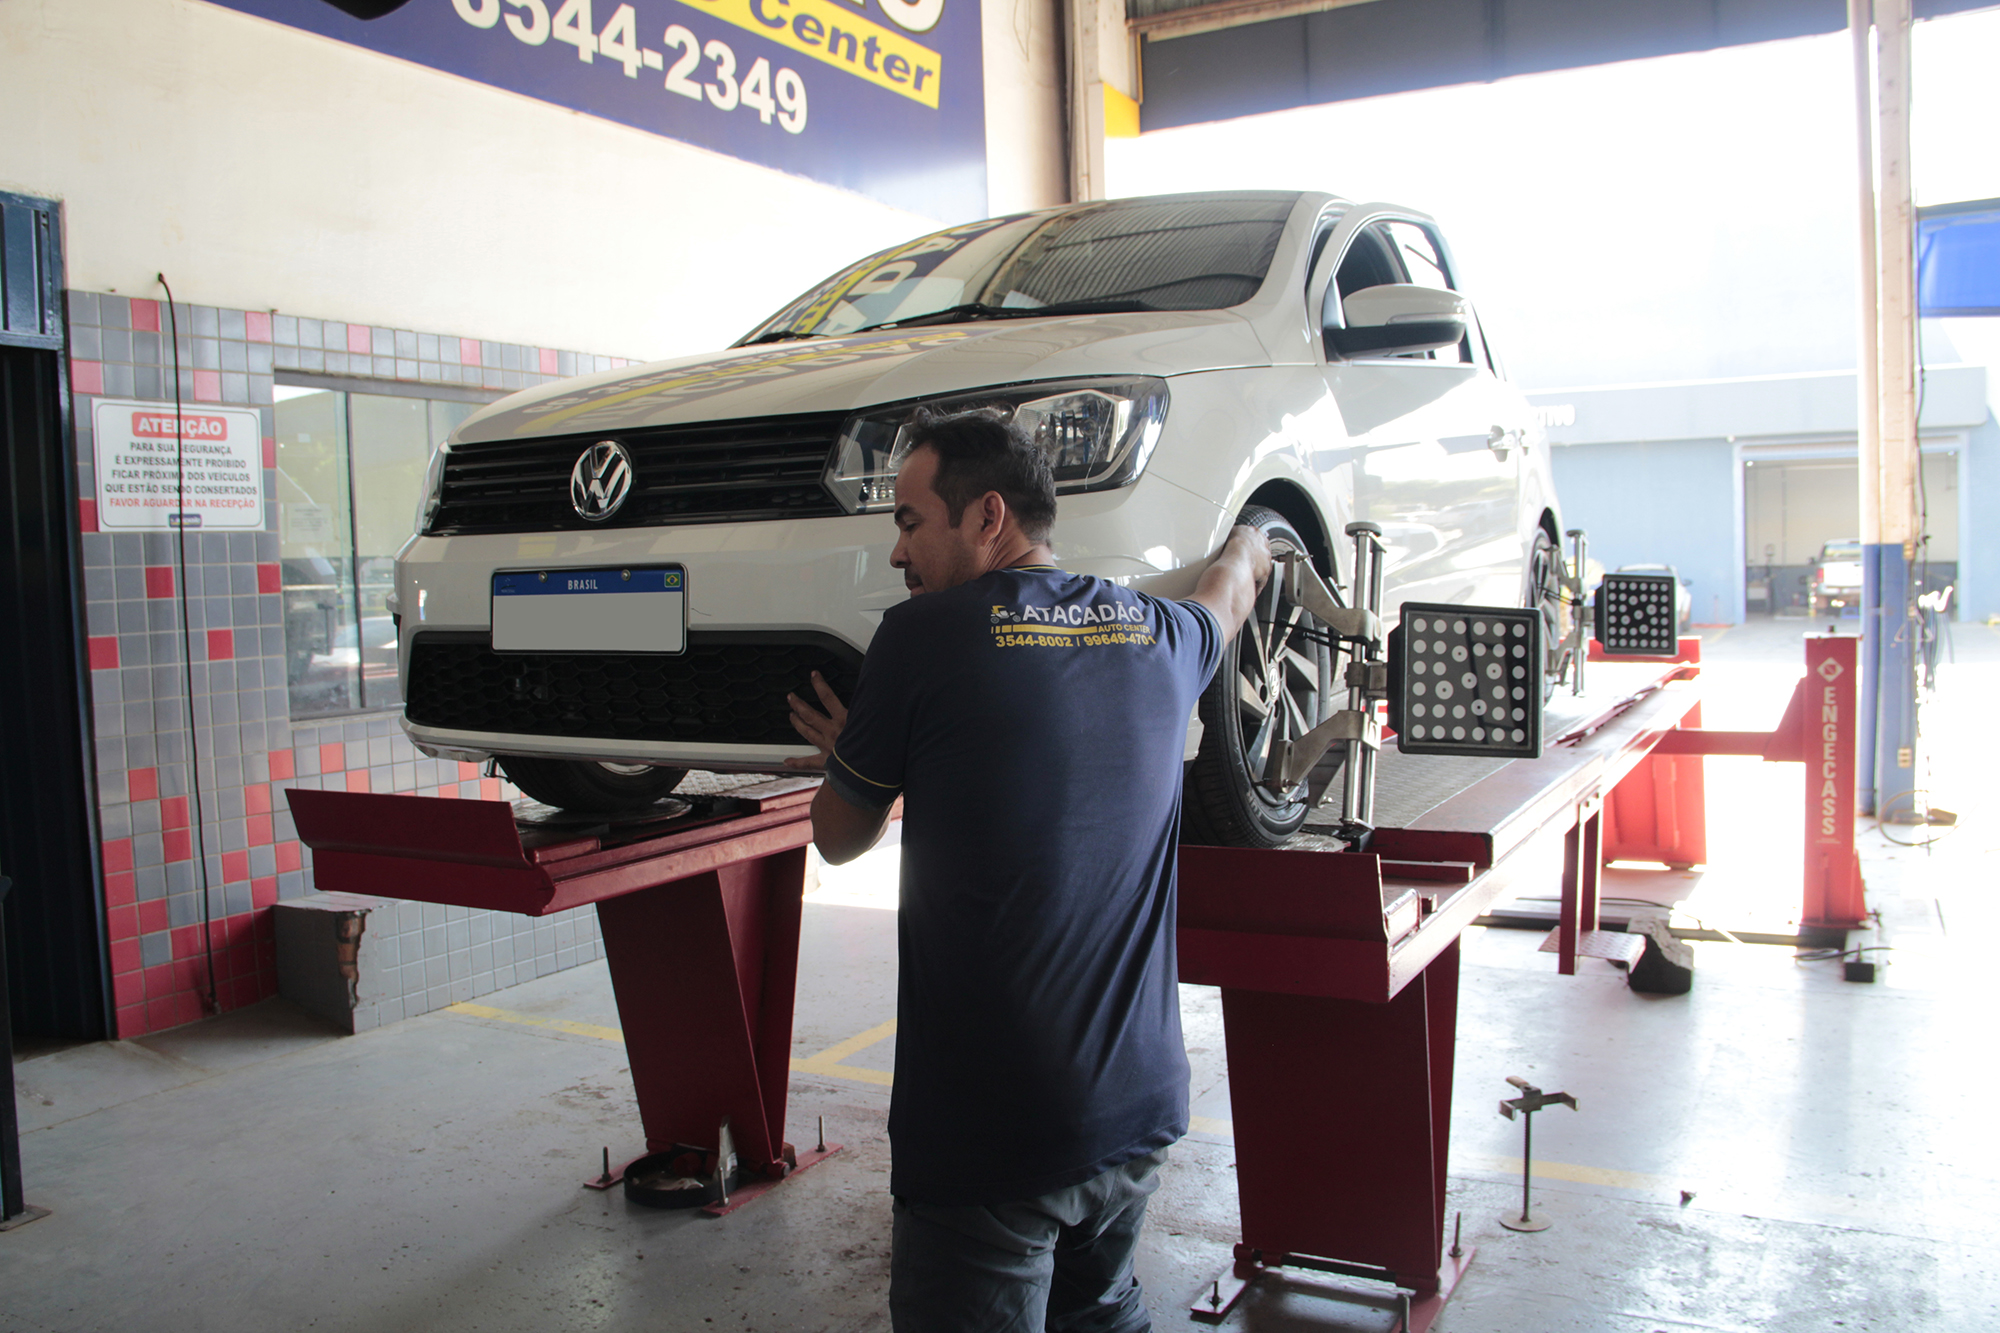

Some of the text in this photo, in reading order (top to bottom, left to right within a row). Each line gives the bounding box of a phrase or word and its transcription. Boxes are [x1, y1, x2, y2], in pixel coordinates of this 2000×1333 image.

[749, 0, 934, 92] Center
[138, 417, 222, 437] ATENÇÃO
[130, 442, 232, 456] PARA SUA EGURANÇA
[115, 455, 122, 465] É
[205, 458, 246, 469] PROIBIDO
[112, 470, 140, 480] FICAR
[187, 472, 206, 481] DOS
[208, 471, 251, 482] VEÍCULOS
[105, 483, 125, 494] QUE
[128, 483, 159, 494] ESTÃO
[194, 485, 257, 495] CONSERTADOS
[110, 498, 140, 507] FAVOR
[195, 499, 207, 508] NA
[210, 499, 255, 510] RECEPÇÃO
[567, 579, 598, 590] BRASIL
[1022, 601, 1145, 625] ATACADÃO
[1098, 624, 1151, 634] AUTO CENTER
[995, 635, 1074, 648] 3544-8002
[1083, 632, 1157, 647] 99649-4701
[1821, 686, 1838, 835] ENGECASS
